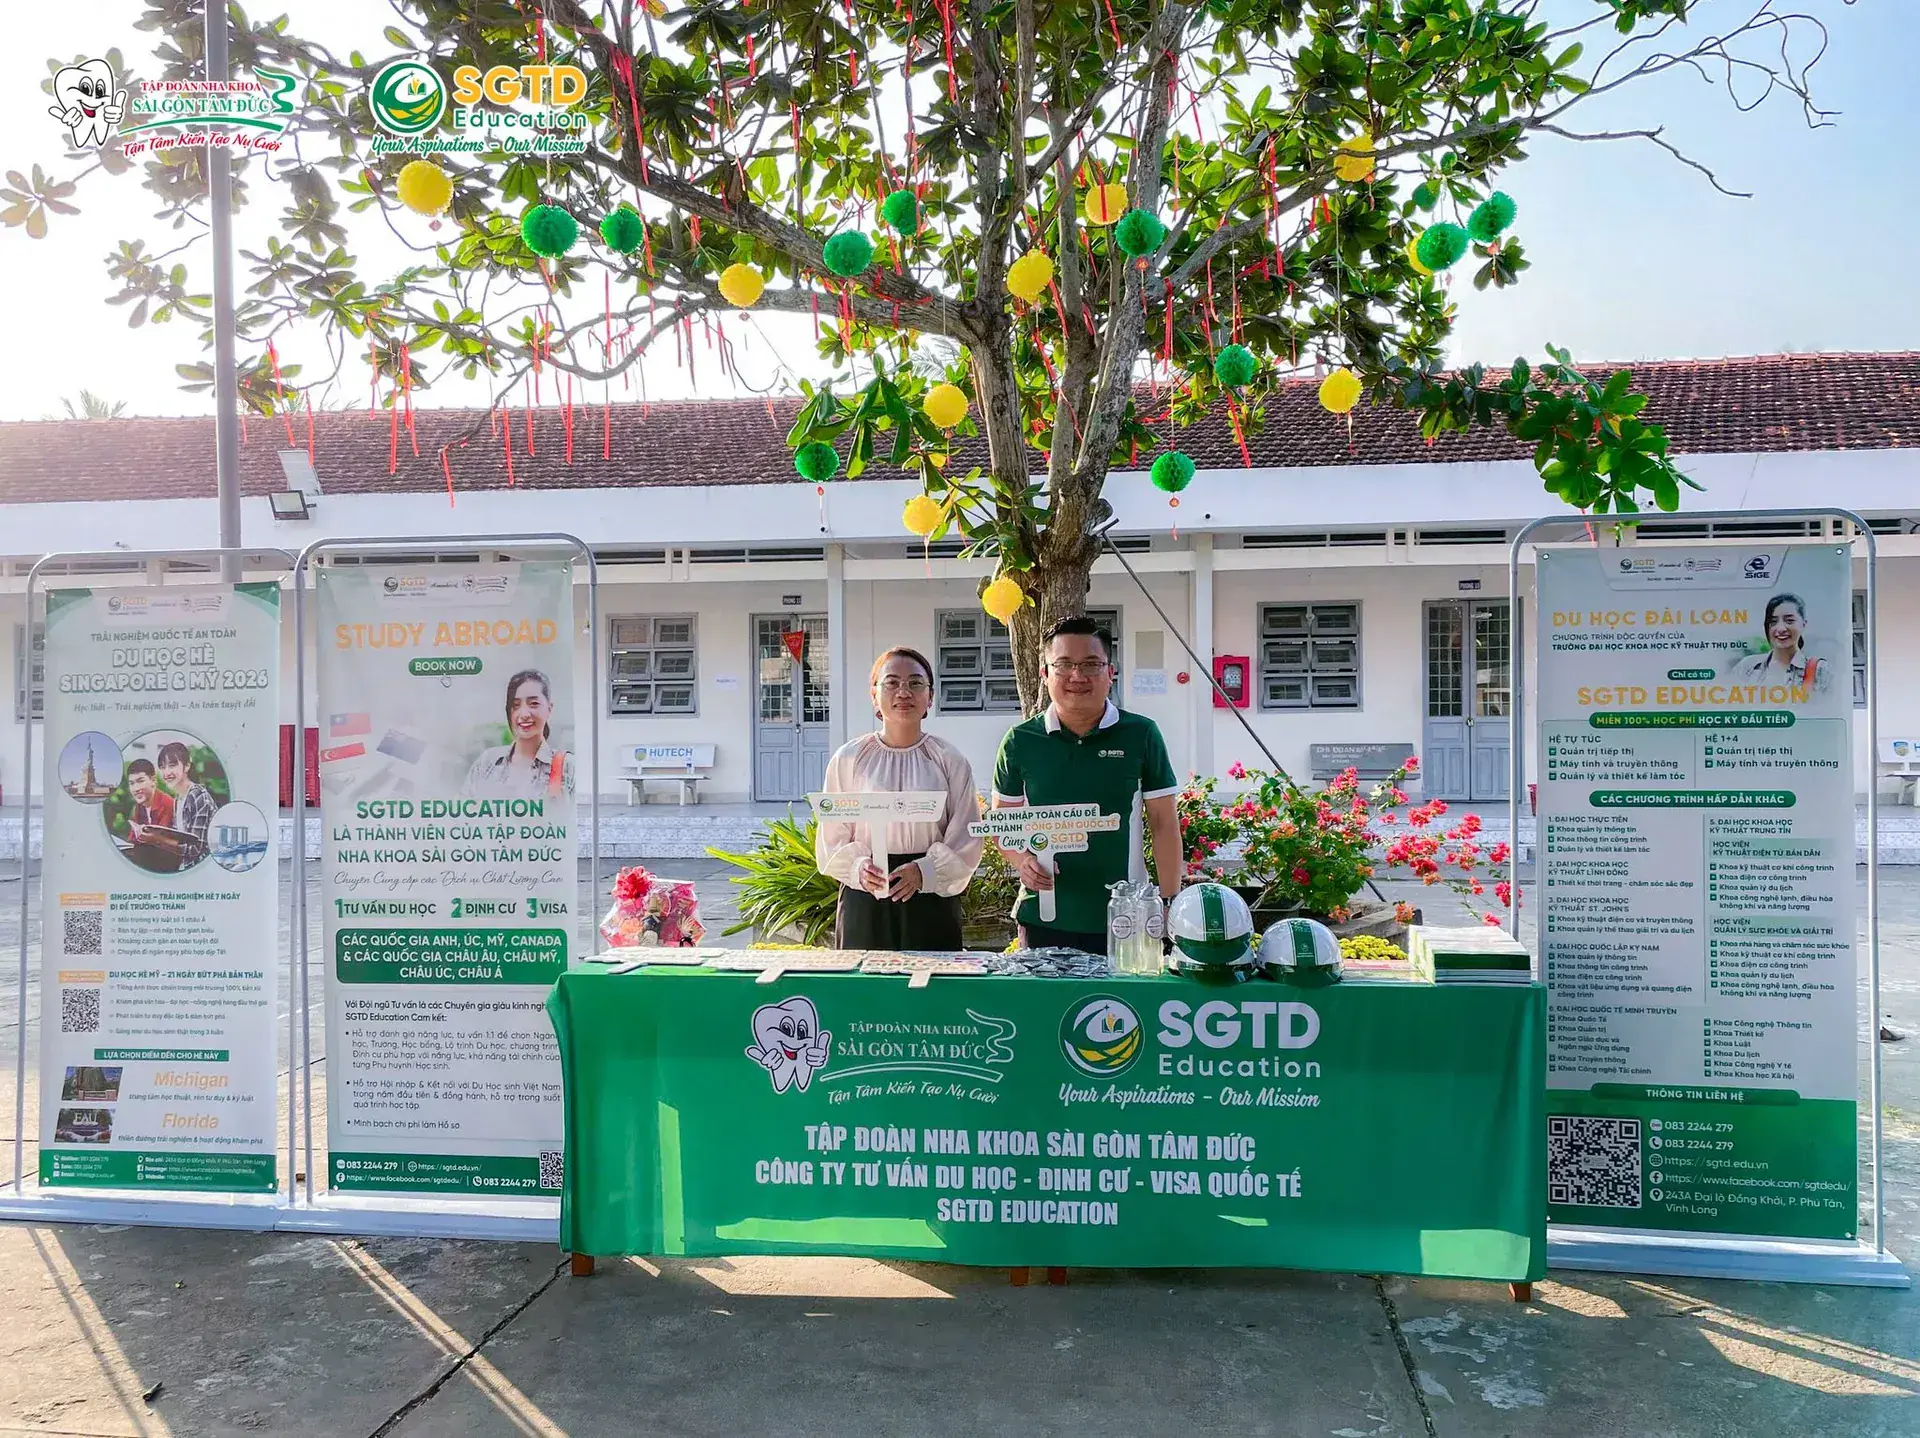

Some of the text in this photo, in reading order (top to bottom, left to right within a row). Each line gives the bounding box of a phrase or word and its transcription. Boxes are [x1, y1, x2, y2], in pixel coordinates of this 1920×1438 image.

[1552, 610, 1582, 627] DU
[1590, 609, 1636, 631] HỌC
[1690, 608, 1749, 625] LOAN
[335, 618, 558, 649] STUDY ABROAD
[112, 643, 215, 670] DU HỌC HÈ
[415, 660, 477, 671] BOOK NOW
[59, 667, 269, 693] SINGAPORE & MỸ 2026
[1577, 684, 1809, 706] SGTD EDUCATION
[1549, 734, 1602, 744] HỆ TỰ TÚC
[649, 748, 693, 757] HUTECH
[1600, 792, 1623, 804] CÁC
[1626, 793, 1672, 804] CHƯƠNG
[1755, 793, 1784, 804] KHÁC
[356, 799, 544, 819] SGTD EDUCATION
[990, 812, 1007, 823] HỘI
[1008, 810, 1034, 822] NHẬP
[334, 822, 566, 844] LÀ THÀNH VIÊN CỦA TẬP ĐOÀN
[971, 824, 990, 834] TRỞ
[1025, 820, 1052, 831] CÔNG
[1002, 834, 1026, 850] Cùng
[1051, 832, 1085, 844] SGTD
[1051, 842, 1086, 850] Education
[1732, 840, 1750, 848] VIỆN
[338, 844, 562, 863] NHA KHOA SÀI GÒN TÂM ĐỨC
[334, 898, 436, 918] 1 TƯ VẤN DU HỌC
[450, 898, 516, 918] 2 ĐỊNH CƯ
[526, 898, 568, 918] 3 VISA
[849, 1021, 979, 1036] TẬP ĐOÀN NHA KHOA
[1156, 1000, 1320, 1049] SGTD
[838, 1038, 986, 1060] SÀI GÒN TÂM ĐỨC
[1158, 1053, 1321, 1078] Education
[154, 1070, 228, 1090] Michigan
[828, 1081, 1000, 1104] Tận Tâm Kiến Tạo Nụ Cười
[1058, 1083, 1098, 1110] Your
[1102, 1083, 1195, 1110] Aspirations
[1219, 1086, 1254, 1106] Our
[1256, 1086, 1321, 1108] Mission
[1646, 1088, 1744, 1102] THÔNG TIN LIÊN HỆ
[162, 1113, 220, 1129] Florida
[804, 1121, 1256, 1162] TẬP ĐOÀN NHA KHOA SÀI GÒN TÂM ĐỨC
[346, 1160, 398, 1170] 083 2244 279
[756, 1156, 813, 1186] CÔNG
[820, 1162, 846, 1186] TY
[852, 1160, 882, 1187] TƯ
[885, 1157, 928, 1188] VẤN
[935, 1165, 964, 1189] DU
[972, 1166, 1016, 1195] HỌC
[1038, 1167, 1092, 1196] ĐỊNH
[1098, 1166, 1131, 1193] CƯ
[1150, 1170, 1202, 1195] VISA
[1208, 1166, 1269, 1198] QUỐC
[1276, 1166, 1302, 1198] TẾ
[937, 1198, 1118, 1225] SGTD EDUCATION
[1692, 1205, 1718, 1216] Long
